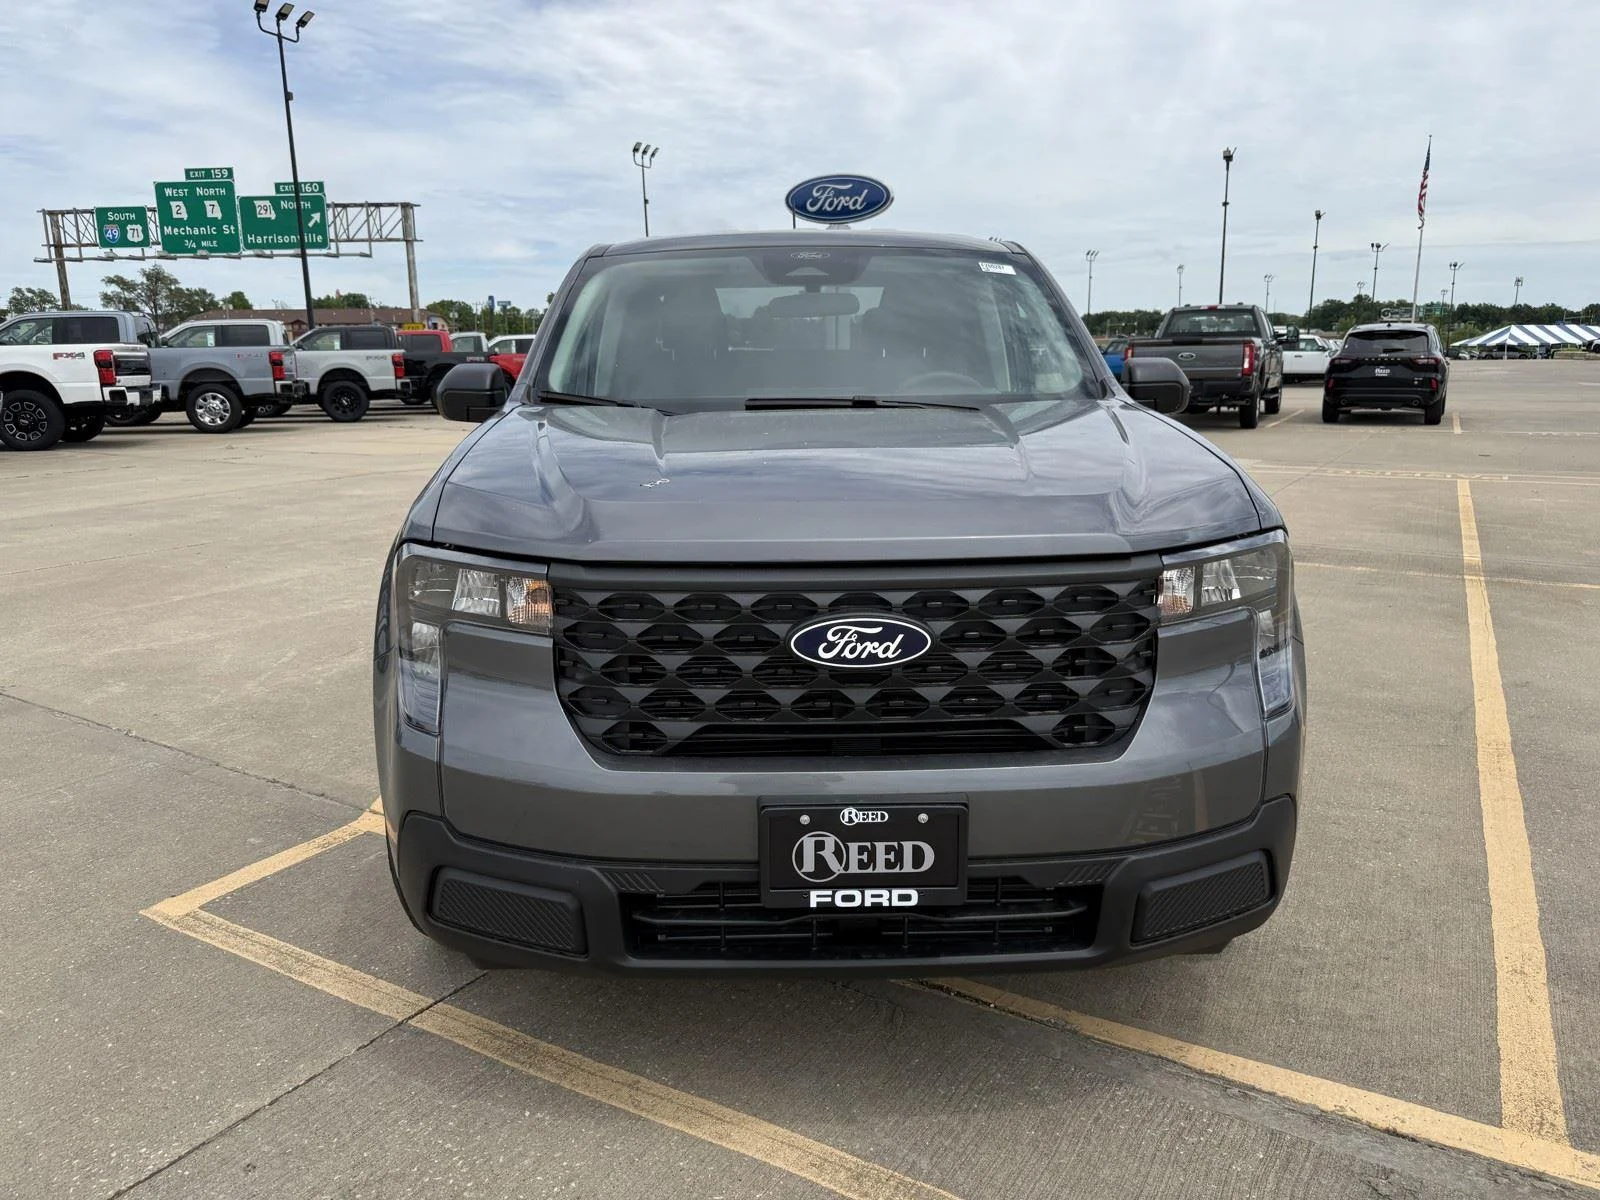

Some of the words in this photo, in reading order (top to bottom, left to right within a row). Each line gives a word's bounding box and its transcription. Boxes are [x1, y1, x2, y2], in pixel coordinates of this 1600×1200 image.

[189, 170, 206, 178] EXIT
[210, 169, 229, 179] 159
[164, 187, 189, 197] WEST
[196, 186, 226, 196] NORTH
[301, 183, 320, 193] 160
[806, 183, 868, 212] Ford
[175, 204, 183, 215] 2
[208, 203, 216, 215] 7
[257, 204, 272, 216] 291
[280, 200, 312, 209] NOTH
[107, 211, 136, 221] SOUTH
[106, 229, 119, 240] 49
[129, 227, 140, 239] 71
[163, 225, 218, 236] Mechanic
[222, 224, 236, 235] St
[201, 240, 218, 248] MILE
[247, 232, 323, 244] Harrisonille
[817, 624, 905, 660] Ford
[840, 807, 889, 826] REED
[792, 831, 935, 883] REED
[809, 889, 919, 908] FORD
